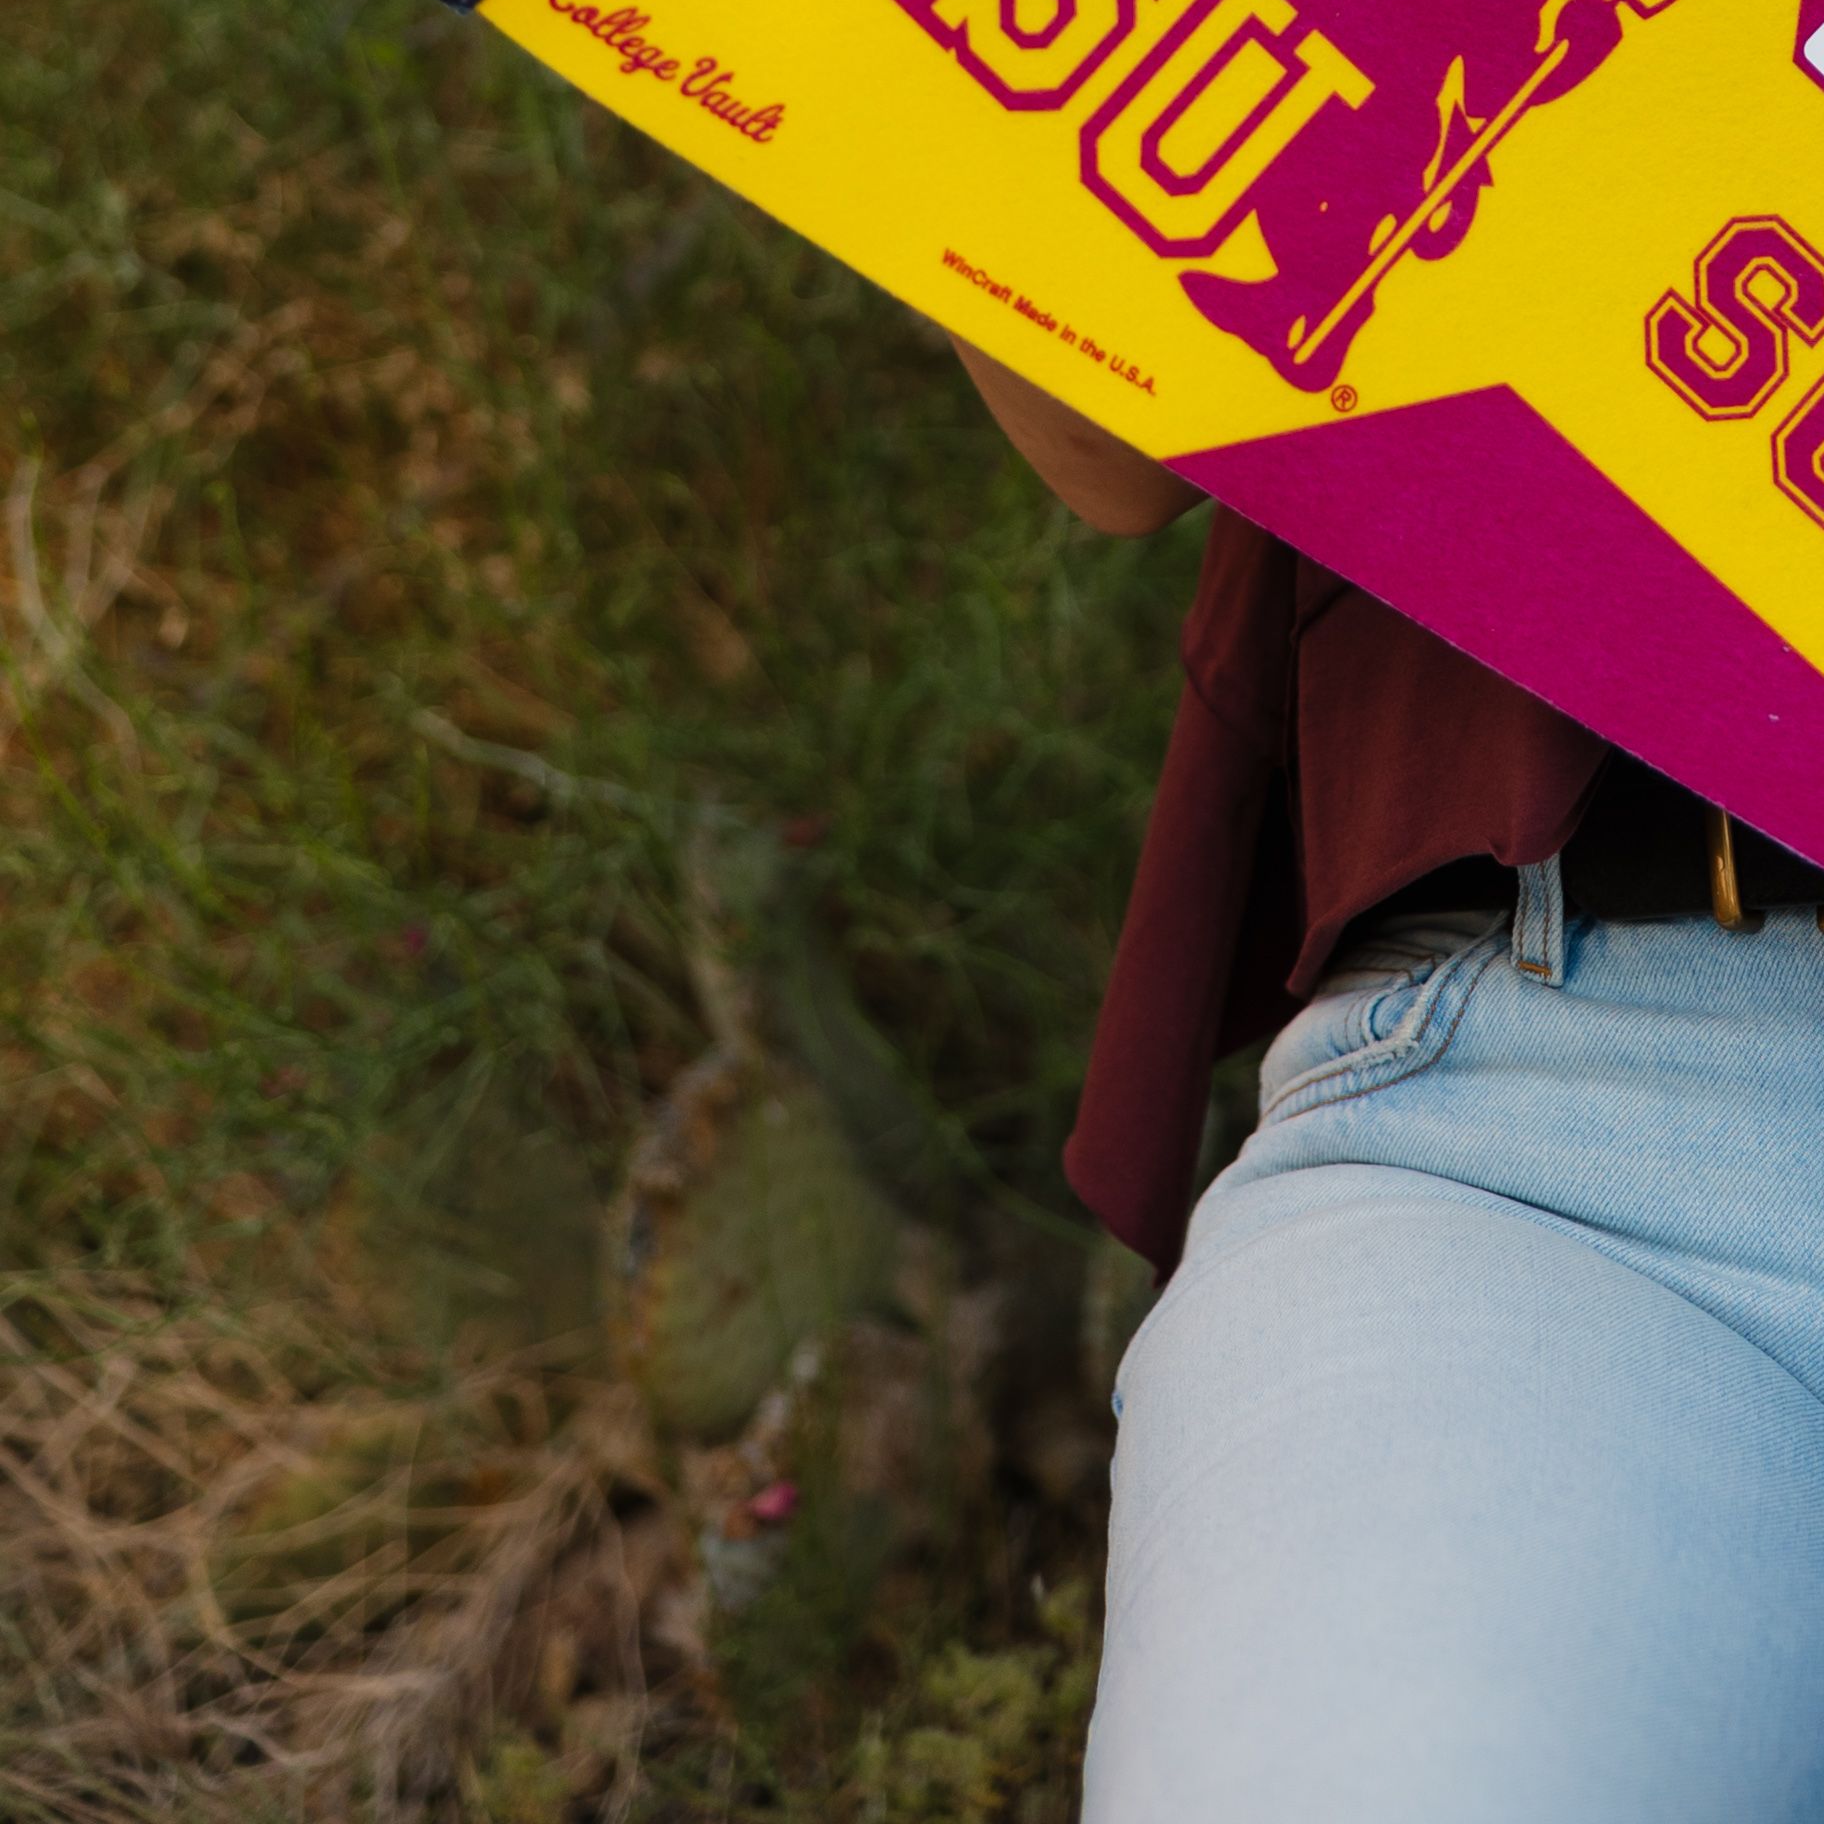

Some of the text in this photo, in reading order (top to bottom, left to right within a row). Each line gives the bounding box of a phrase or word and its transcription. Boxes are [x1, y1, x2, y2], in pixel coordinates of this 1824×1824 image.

[680, 56, 786, 143] Vault
[942, 248, 1013, 303] WinCraft
[1013, 296, 1057, 331] Made
[1079, 338, 1106, 362] the
[1109, 355, 1156, 396] U.S.A.
